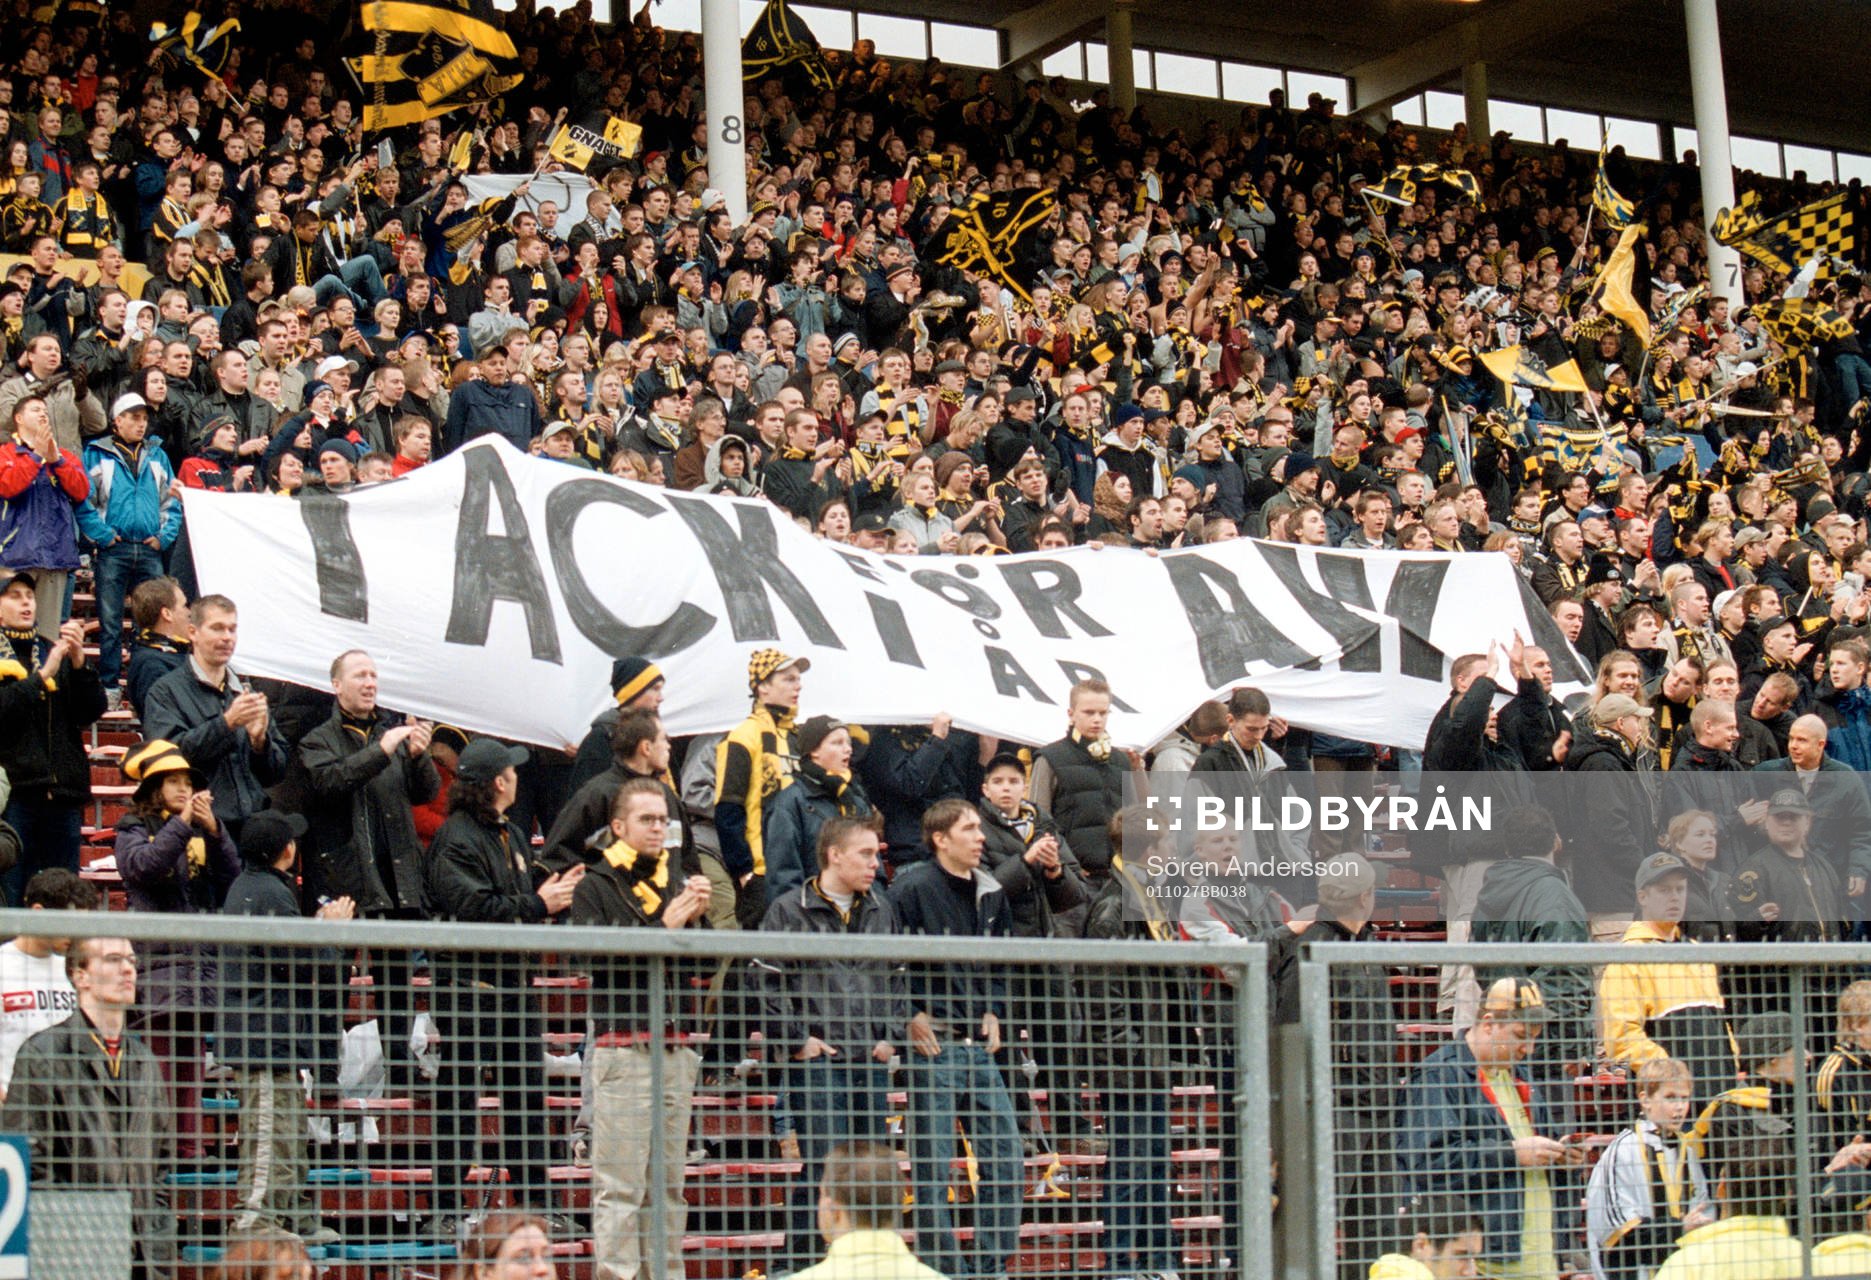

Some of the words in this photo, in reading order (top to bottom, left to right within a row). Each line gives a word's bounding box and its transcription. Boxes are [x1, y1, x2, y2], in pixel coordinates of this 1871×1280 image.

[569, 125, 623, 159] GNAGET
[721, 115, 742, 144] 8
[1724, 263, 1738, 287] 7
[37, 989, 78, 1011] DIESE
